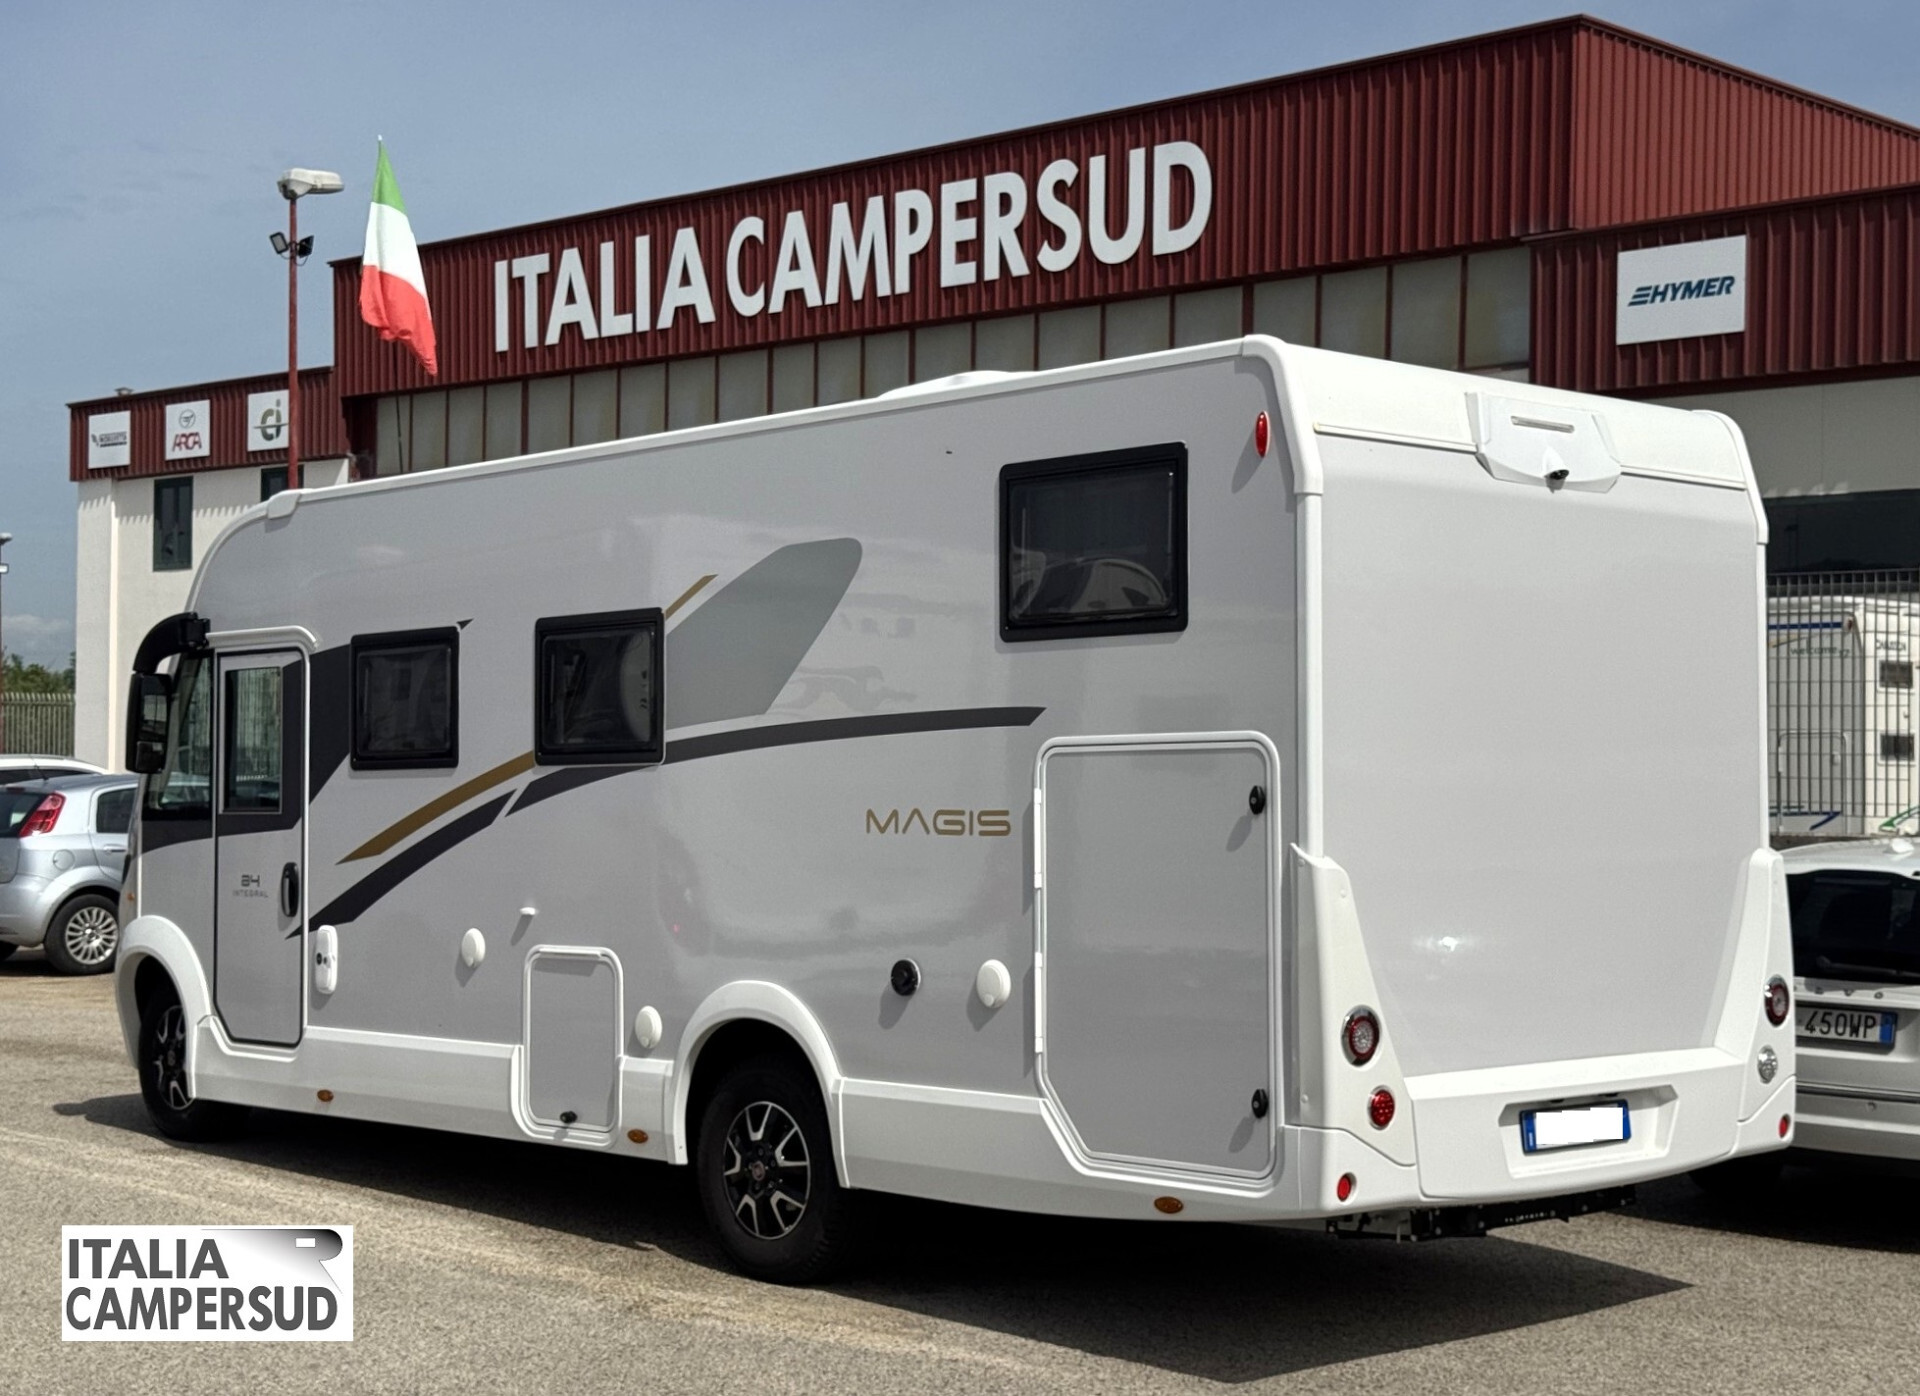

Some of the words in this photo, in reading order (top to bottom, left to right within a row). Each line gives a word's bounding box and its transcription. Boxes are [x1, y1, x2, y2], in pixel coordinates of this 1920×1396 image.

[495, 227, 716, 352] ITALIA
[726, 141, 1212, 317] CAMPERSUD
[1648, 275, 1736, 305] HYMER
[172, 432, 203, 452] ARCA
[866, 807, 1012, 836] MAGIS
[1804, 1010, 1877, 1039] 450WP
